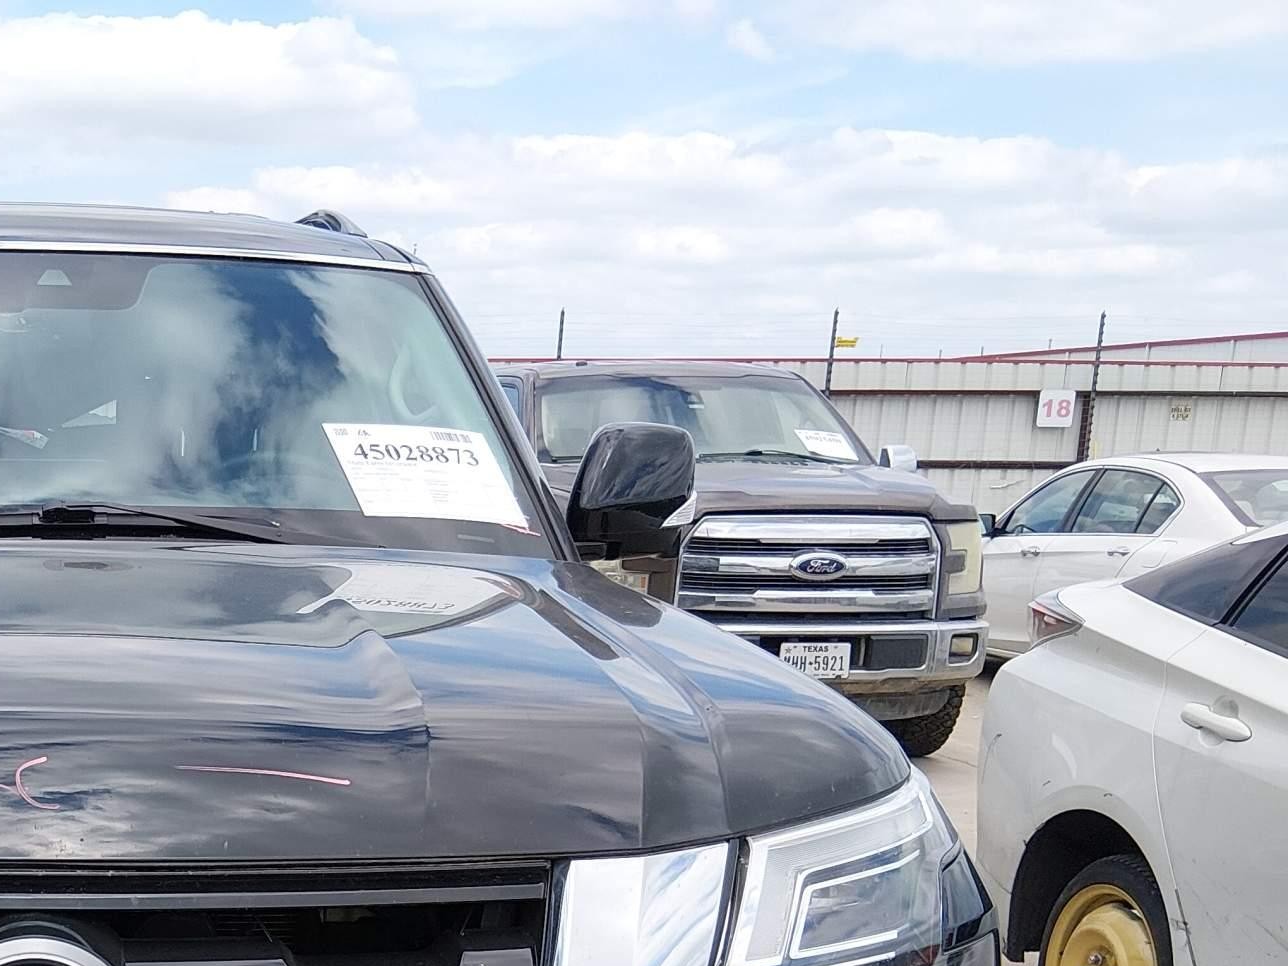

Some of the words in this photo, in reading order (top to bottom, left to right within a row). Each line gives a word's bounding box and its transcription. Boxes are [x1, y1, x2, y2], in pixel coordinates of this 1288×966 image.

[1042, 398, 1072, 418] 18
[353, 442, 480, 467] 45028873
[806, 559, 838, 573] Ford
[803, 645, 829, 653] TEXAS
